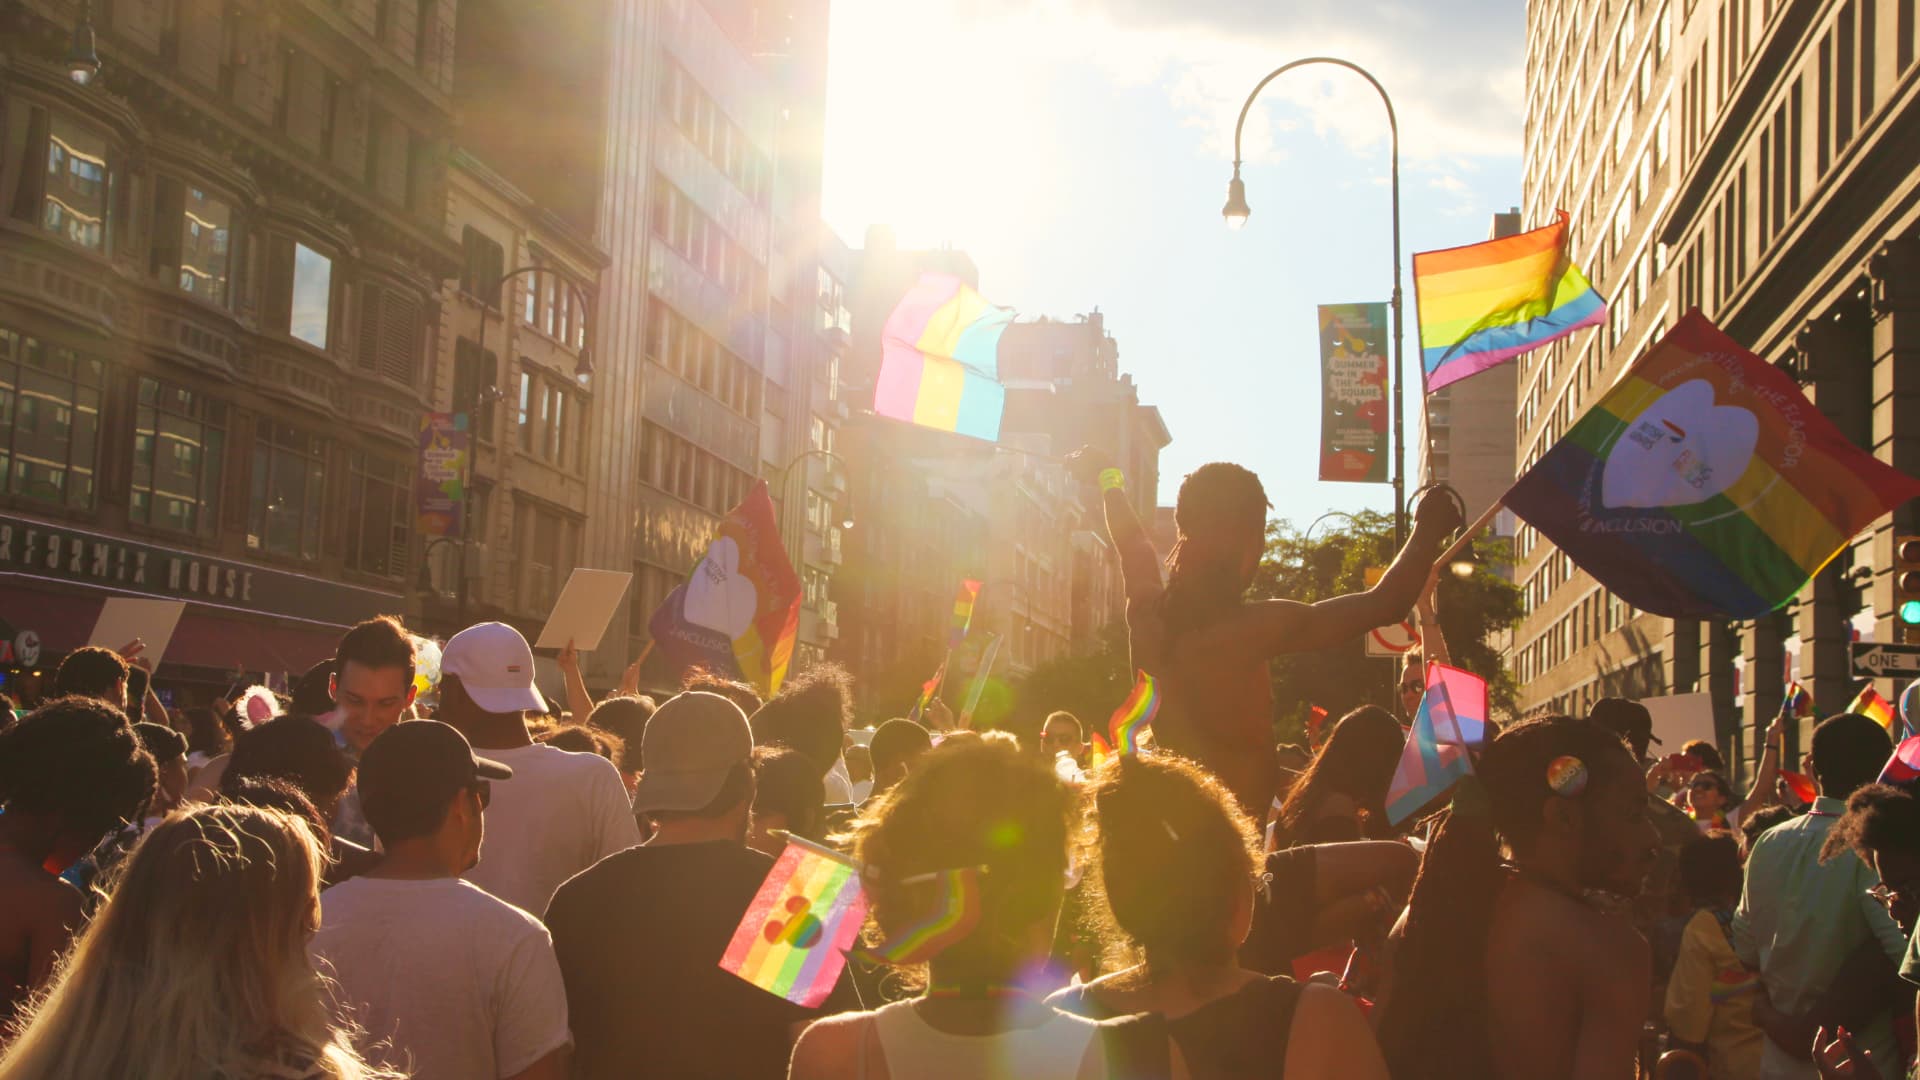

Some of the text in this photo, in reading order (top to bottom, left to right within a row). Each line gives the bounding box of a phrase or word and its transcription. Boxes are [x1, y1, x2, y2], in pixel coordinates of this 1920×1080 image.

[1334, 360, 1376, 369] SUMMER
[1346, 370, 1357, 378] IN
[1336, 379, 1352, 387] THE
[1340, 388, 1378, 397] SQUARE
[168, 558, 253, 601] HOUSE
[677, 631, 730, 654] INCLUSIO
[1869, 654, 1900, 667] ONE
